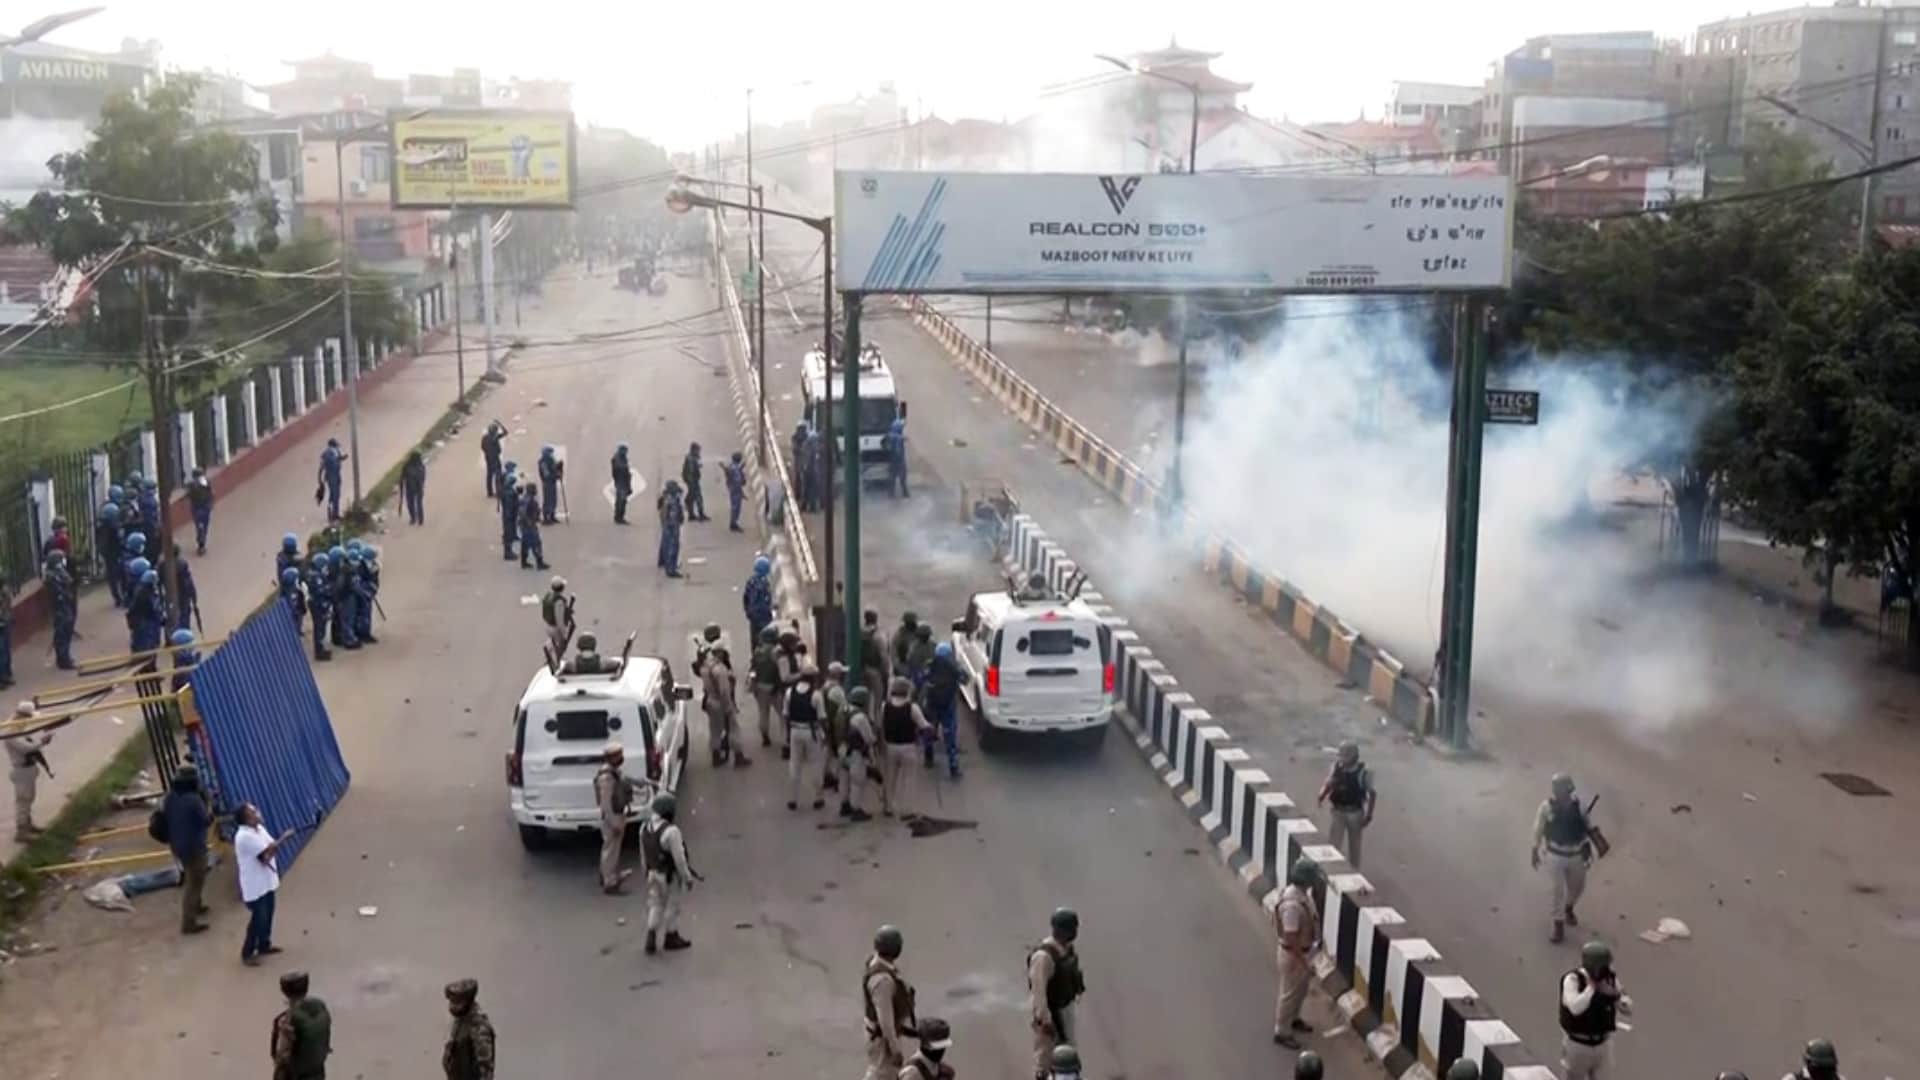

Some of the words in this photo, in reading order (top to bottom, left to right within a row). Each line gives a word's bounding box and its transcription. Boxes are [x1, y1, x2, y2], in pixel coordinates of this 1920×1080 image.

[19, 59, 109, 81] AVIATION
[1029, 221, 1141, 237] REALCON
[1040, 250, 1108, 263] MAZBOOT
[1111, 251, 1146, 263] NEEV
[1149, 251, 1165, 263] KE
[1167, 251, 1194, 263] LIYE
